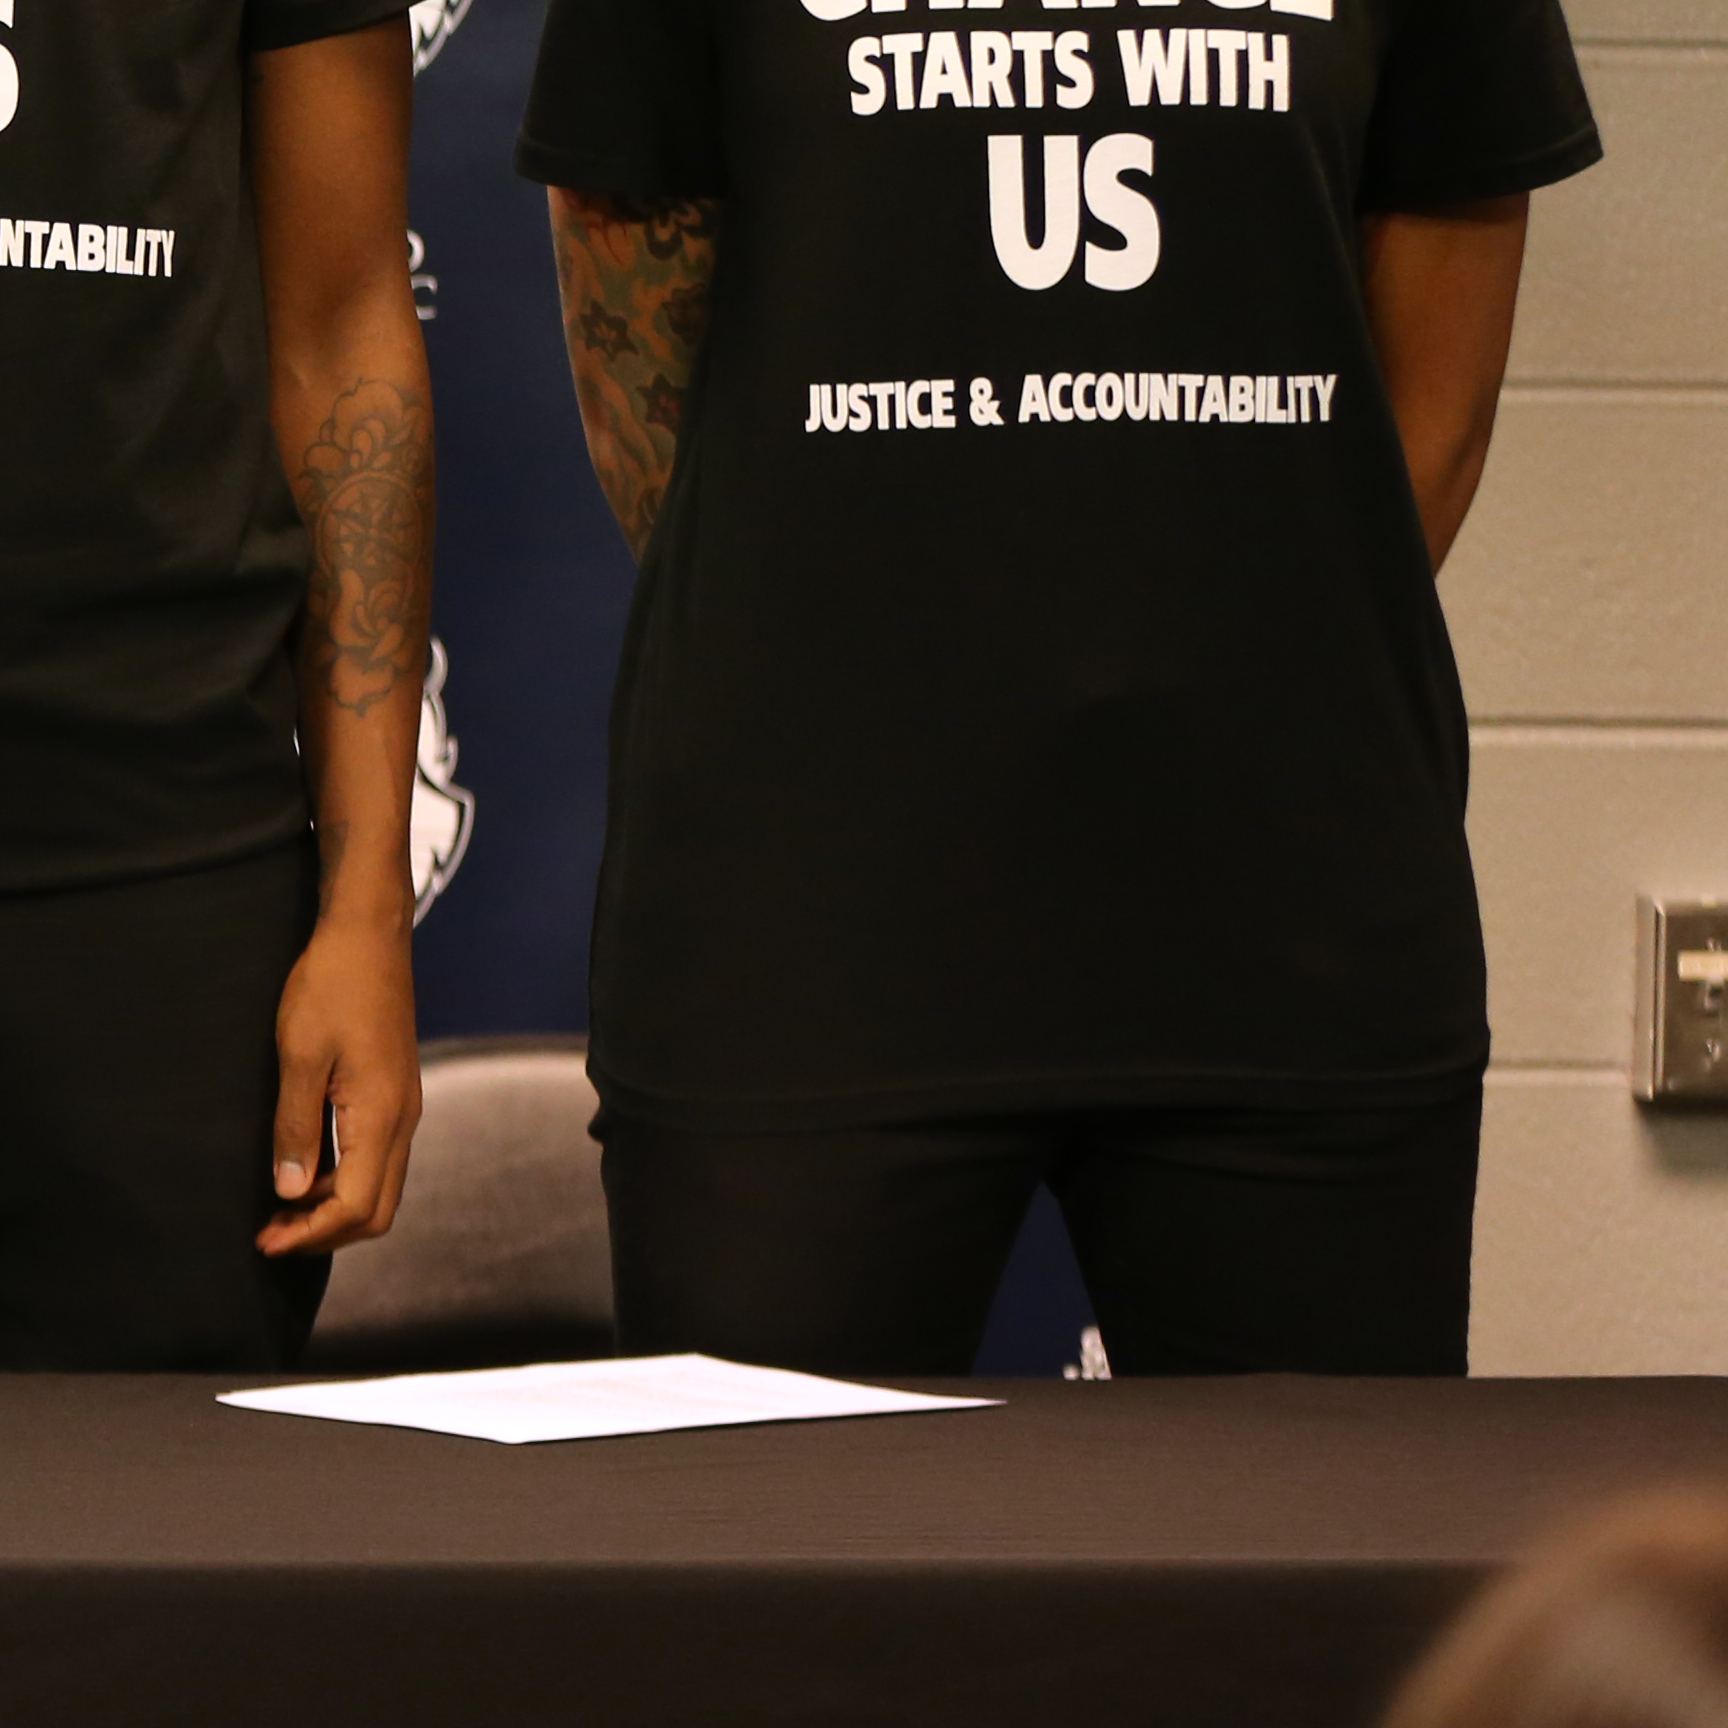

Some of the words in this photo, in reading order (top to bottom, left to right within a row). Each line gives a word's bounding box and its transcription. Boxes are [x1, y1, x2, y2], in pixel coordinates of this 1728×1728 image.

[848, 30, 1095, 116] STARTS
[1116, 28, 1290, 112] WITH
[987, 133, 1161, 291] US
[805, 379, 957, 433] JUSTICE
[969, 377, 1005, 426] &
[1017, 372, 1339, 424] ACCOUNTABILITY
